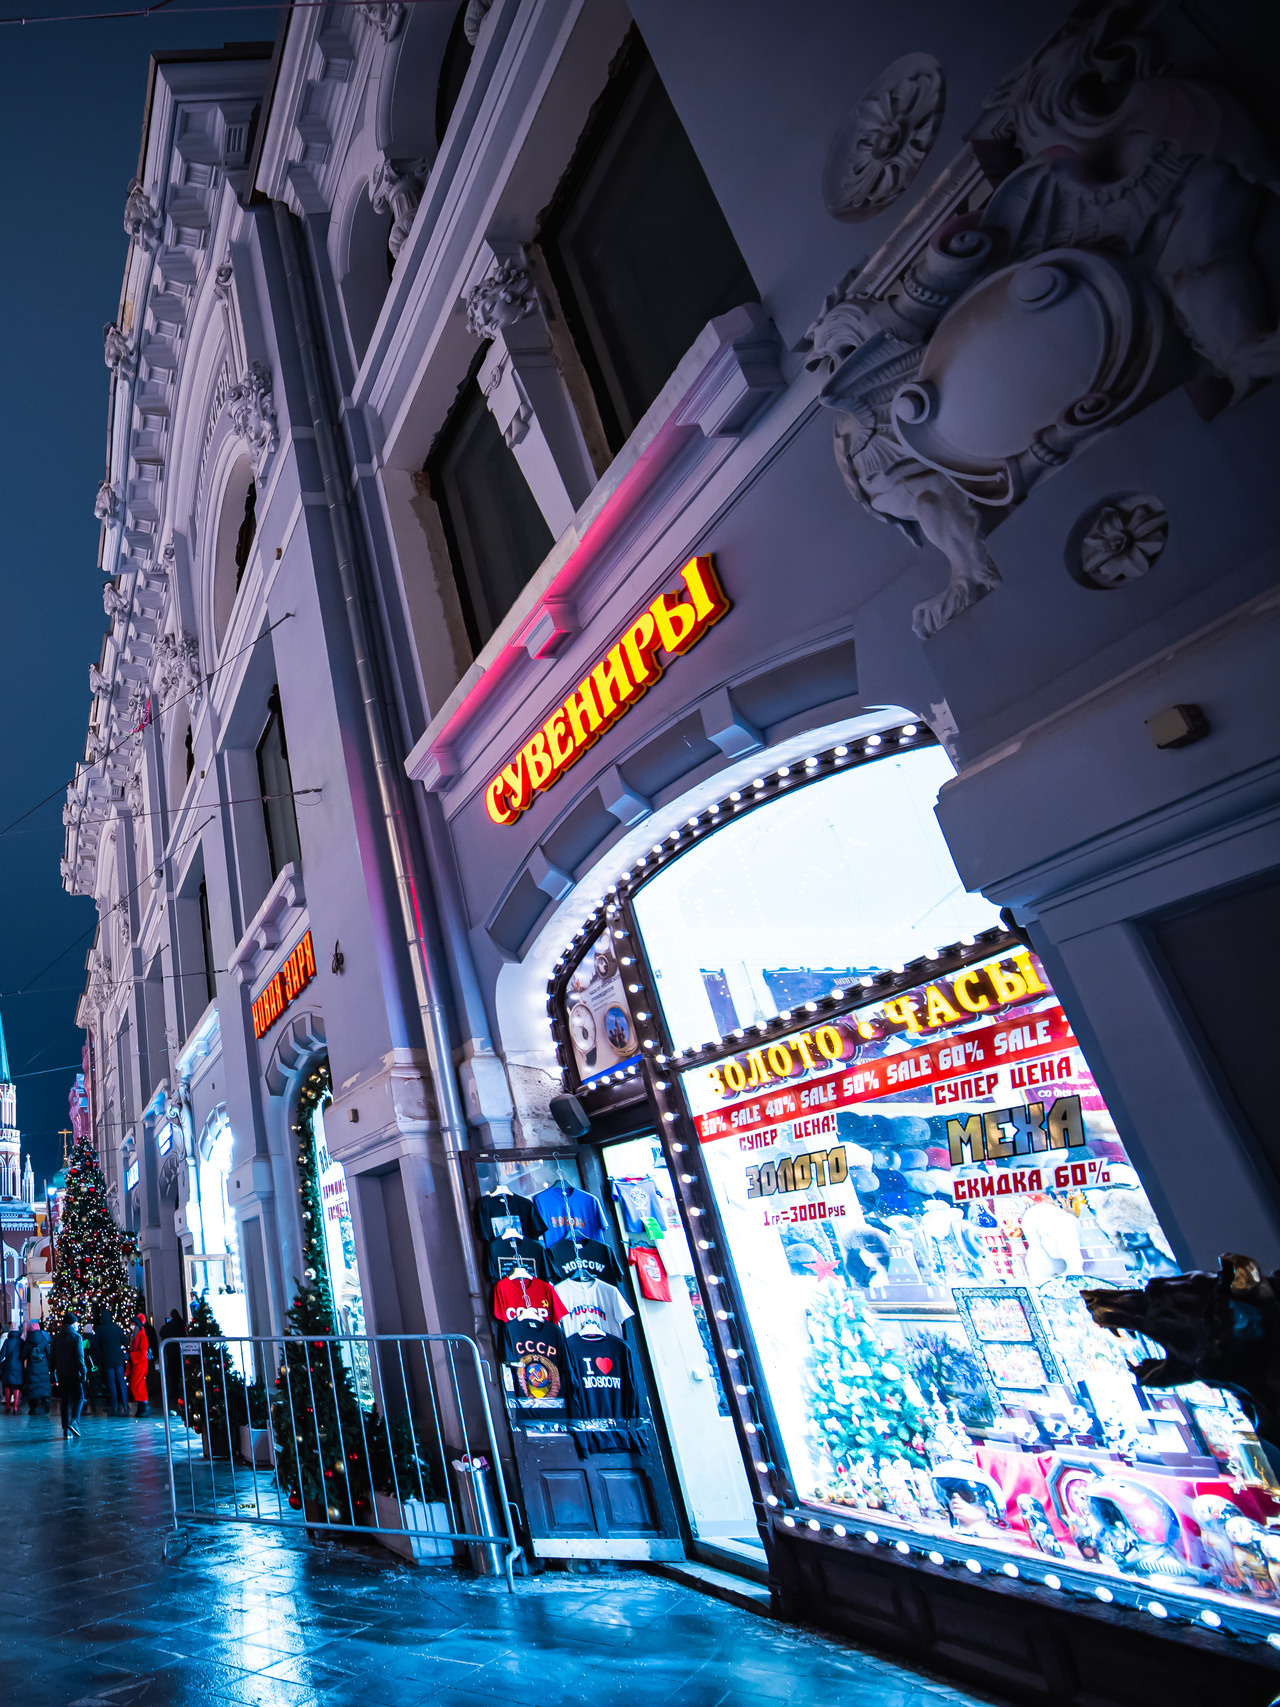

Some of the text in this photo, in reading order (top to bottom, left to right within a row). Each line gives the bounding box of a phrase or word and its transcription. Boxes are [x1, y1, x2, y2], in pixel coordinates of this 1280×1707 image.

[485, 554, 727, 825] СУВЕНИРЫ
[252, 931, 317, 1039] НОВАЯ ЗАРЯ
[707, 951, 1047, 1096] ЗОЛОТО ЧАСЫ
[730, 1107, 762, 1129] SALE
[765, 1094, 796, 1118] 40%
[800, 1082, 837, 1109] SALE
[842, 1070, 880, 1098] 50%
[886, 1054, 933, 1085] SALE
[938, 1040, 984, 1071] 60%
[994, 1020, 1052, 1056] SALE
[934, 1056, 1072, 1106] СУПЕР ЦЕНА
[739, 1114, 837, 1151] СУПЕР ЦЕНА!
[946, 1094, 1087, 1167] МЕХА
[745, 1145, 849, 1199] ЗОЛОТО
[953, 1161, 1111, 1201] СКИДКА 60%
[561, 1259, 606, 1274] MOSCOW
[515, 1340, 557, 1357] СССР
[582, 1357, 595, 1375] I
[582, 1376, 621, 1389] MOSCOW
